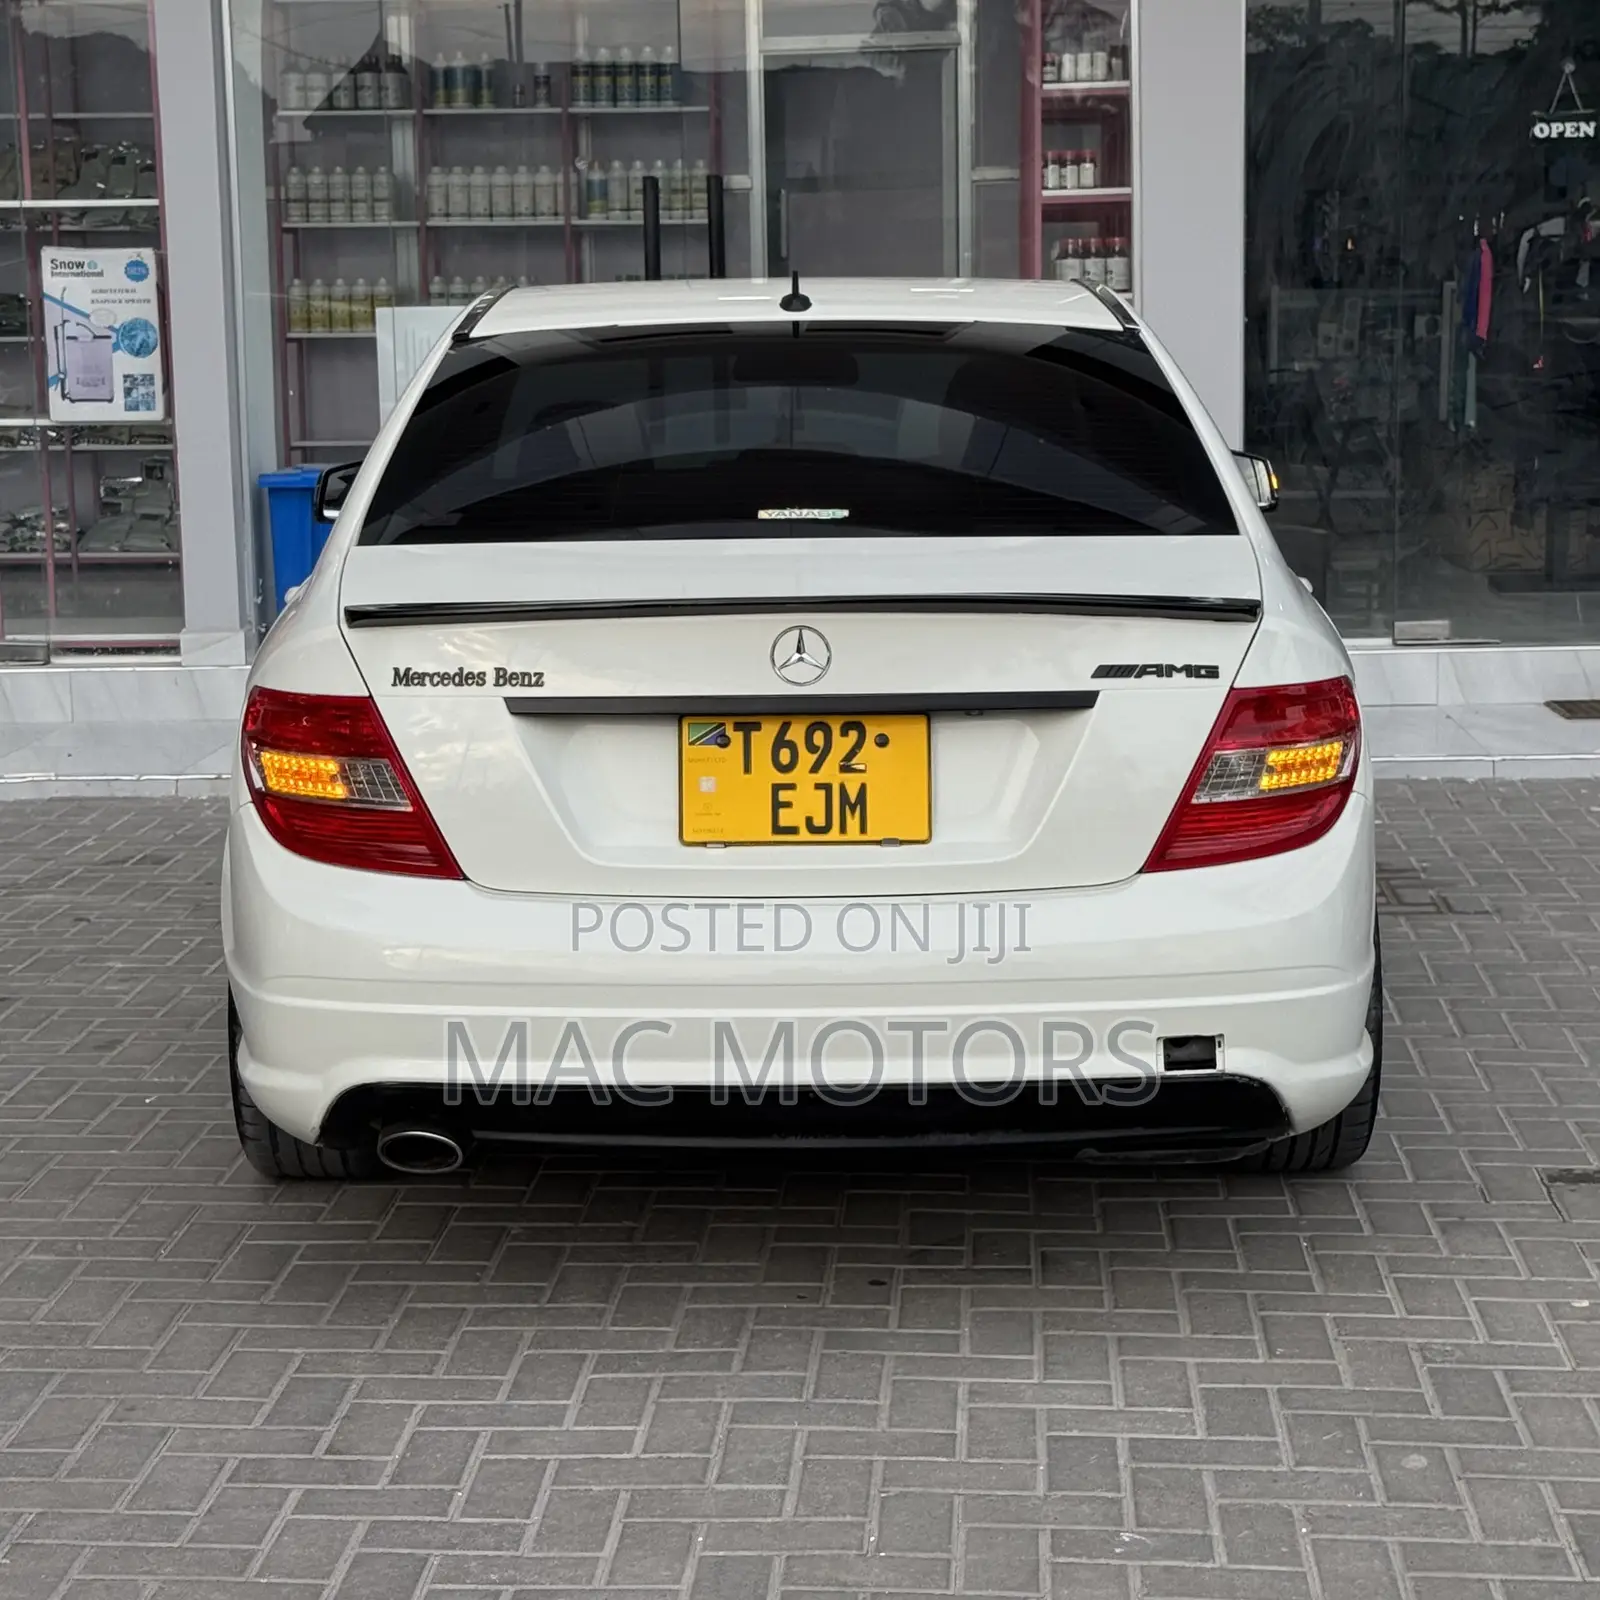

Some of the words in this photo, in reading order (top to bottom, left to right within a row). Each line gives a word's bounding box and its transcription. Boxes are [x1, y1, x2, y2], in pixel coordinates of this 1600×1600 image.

[1533, 121, 1597, 139] OPEN
[50, 258, 86, 270] Snow
[51, 269, 104, 278] International
[391, 666, 487, 687] Mercedes
[493, 667, 545, 687] Benz
[1133, 663, 1220, 679] AMG
[771, 782, 868, 835] EJM
